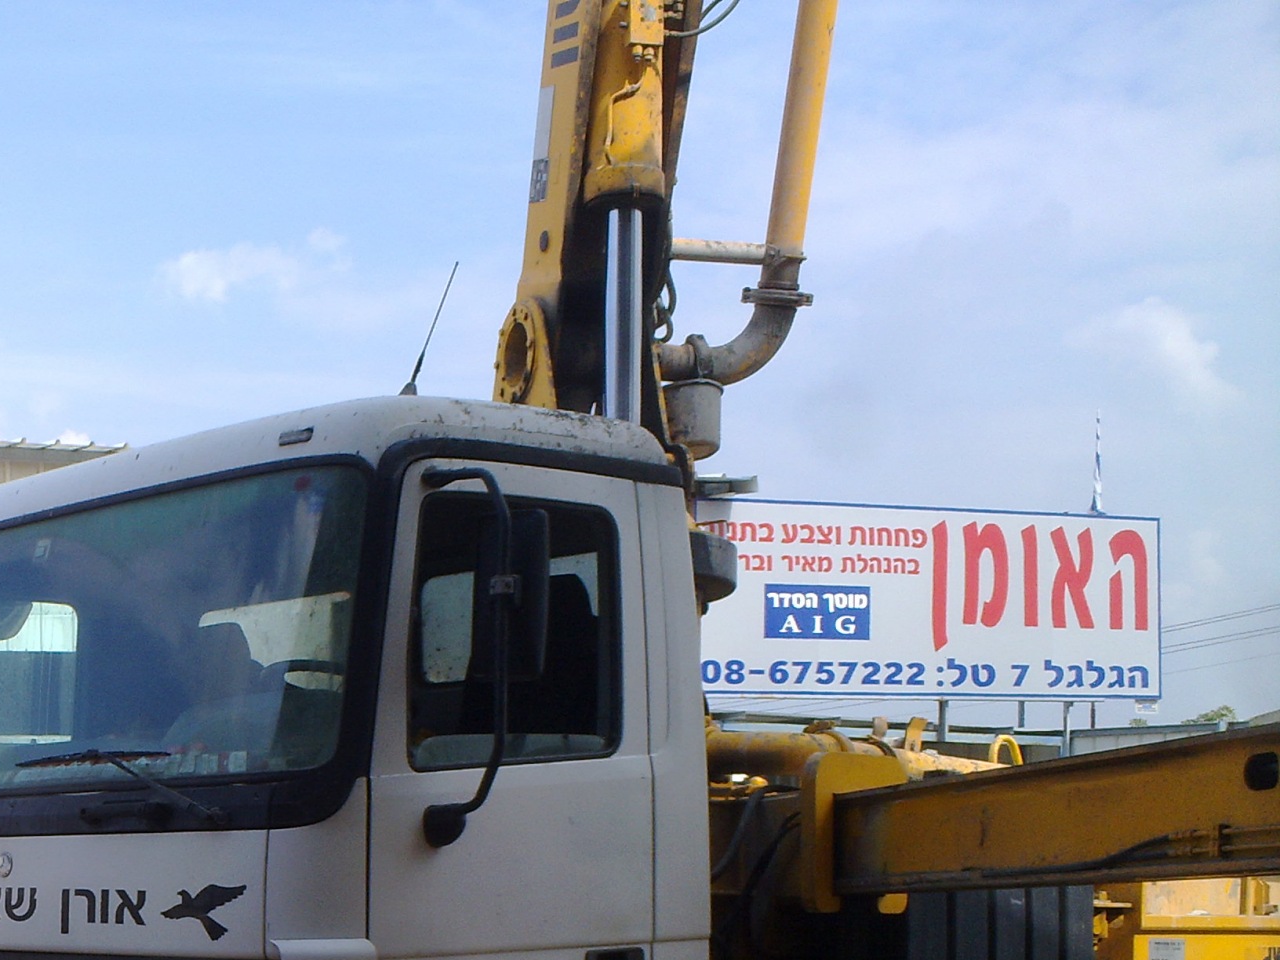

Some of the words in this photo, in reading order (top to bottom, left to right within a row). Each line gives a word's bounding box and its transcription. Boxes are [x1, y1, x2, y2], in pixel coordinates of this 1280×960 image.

[780, 523, 842, 545] וצבע
[847, 525, 928, 549] פחחות
[780, 554, 833, 573] מאיר
[840, 553, 921, 575] בהנהלת
[931, 520, 1149, 652] האומן
[766, 592, 818, 609] הסדר
[822, 593, 868, 613] מוסך
[700, 659, 926, 686] 08-6757222
[936, 658, 996, 688] טל:
[1010, 664, 1030, 687] 7
[1044, 658, 1149, 689] הגלגל
[60, 888, 147, 934] אורן
